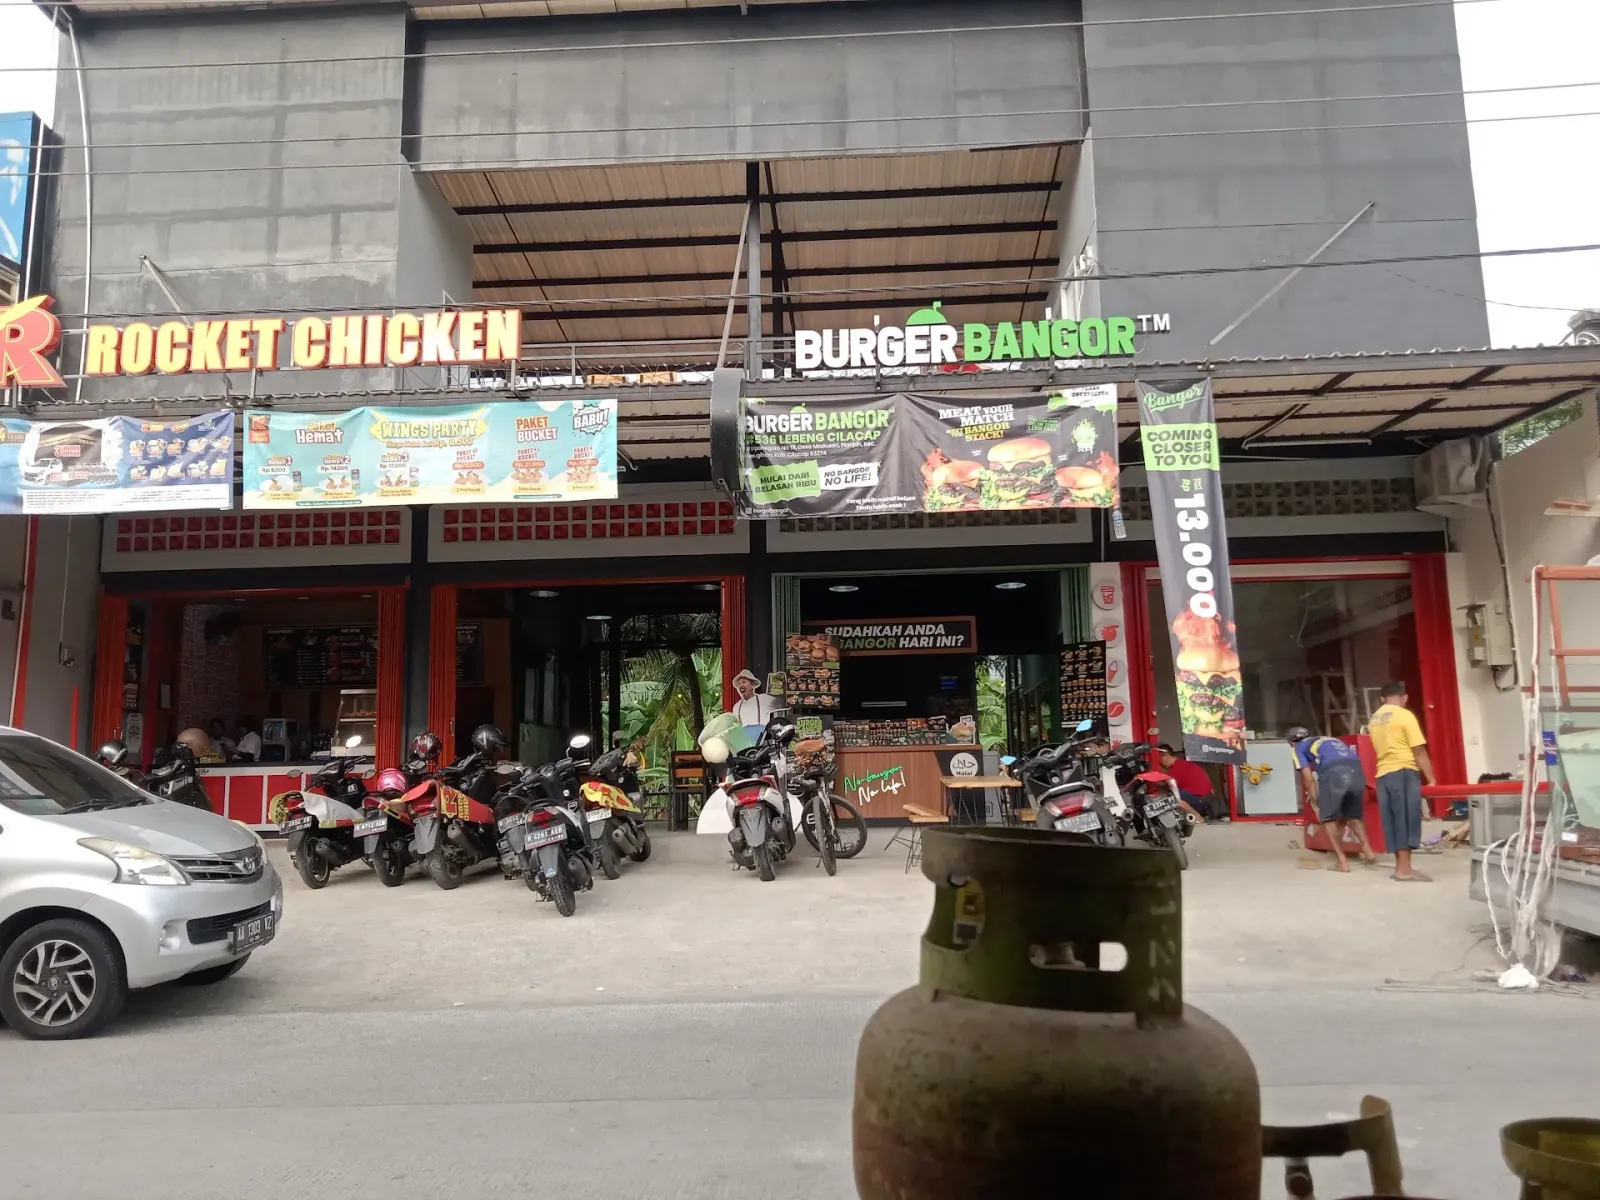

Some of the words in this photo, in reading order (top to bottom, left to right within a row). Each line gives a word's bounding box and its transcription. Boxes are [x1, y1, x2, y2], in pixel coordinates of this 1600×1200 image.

[86, 317, 286, 376] ROCKET
[292, 308, 522, 370] CHICKEN
[795, 325, 958, 370] BURGER
[964, 316, 1136, 362] BANGOR
[1144, 383, 1202, 409] Bangor
[573, 407, 610, 430] BARU!
[938, 406, 981, 420] MEAT
[983, 404, 1014, 414] YOUR
[961, 412, 1015, 426] MATCH
[516, 416, 548, 429] PAKET
[746, 413, 812, 433] BURGER
[815, 409, 889, 431] BANGOR
[965, 422, 1010, 434] BANGOR
[295, 428, 344, 443] Hemat
[381, 421, 430, 439] WINGS
[431, 419, 478, 437] PARTY
[517, 427, 558, 443] BUCKET
[965, 430, 1004, 441] STACK!
[1147, 428, 1212, 442] COMING
[779, 433, 824, 444] LEBENG
[827, 430, 882, 441] CILACAP
[1151, 441, 1211, 454] CLOSER
[1154, 455, 1176, 466] TO
[1180, 453, 1212, 466] YOU
[760, 475, 786, 484] MULAI
[788, 472, 809, 481] DARI
[824, 470, 836, 478] NO
[837, 466, 870, 475] BANGOR
[825, 476, 841, 486] NO
[844, 472, 871, 484] LIFE!
[755, 482, 793, 493] BELASAN
[796, 480, 817, 488] RIBU
[1174, 493, 1218, 618] 13.000
[824, 625, 902, 638] SUDAHKAH
[904, 623, 945, 635] ANDA
[899, 636, 932, 648] HARI
[936, 635, 965, 647] INI?
[952, 758, 976, 769] حلال
[248, 919, 260, 937] 1303
